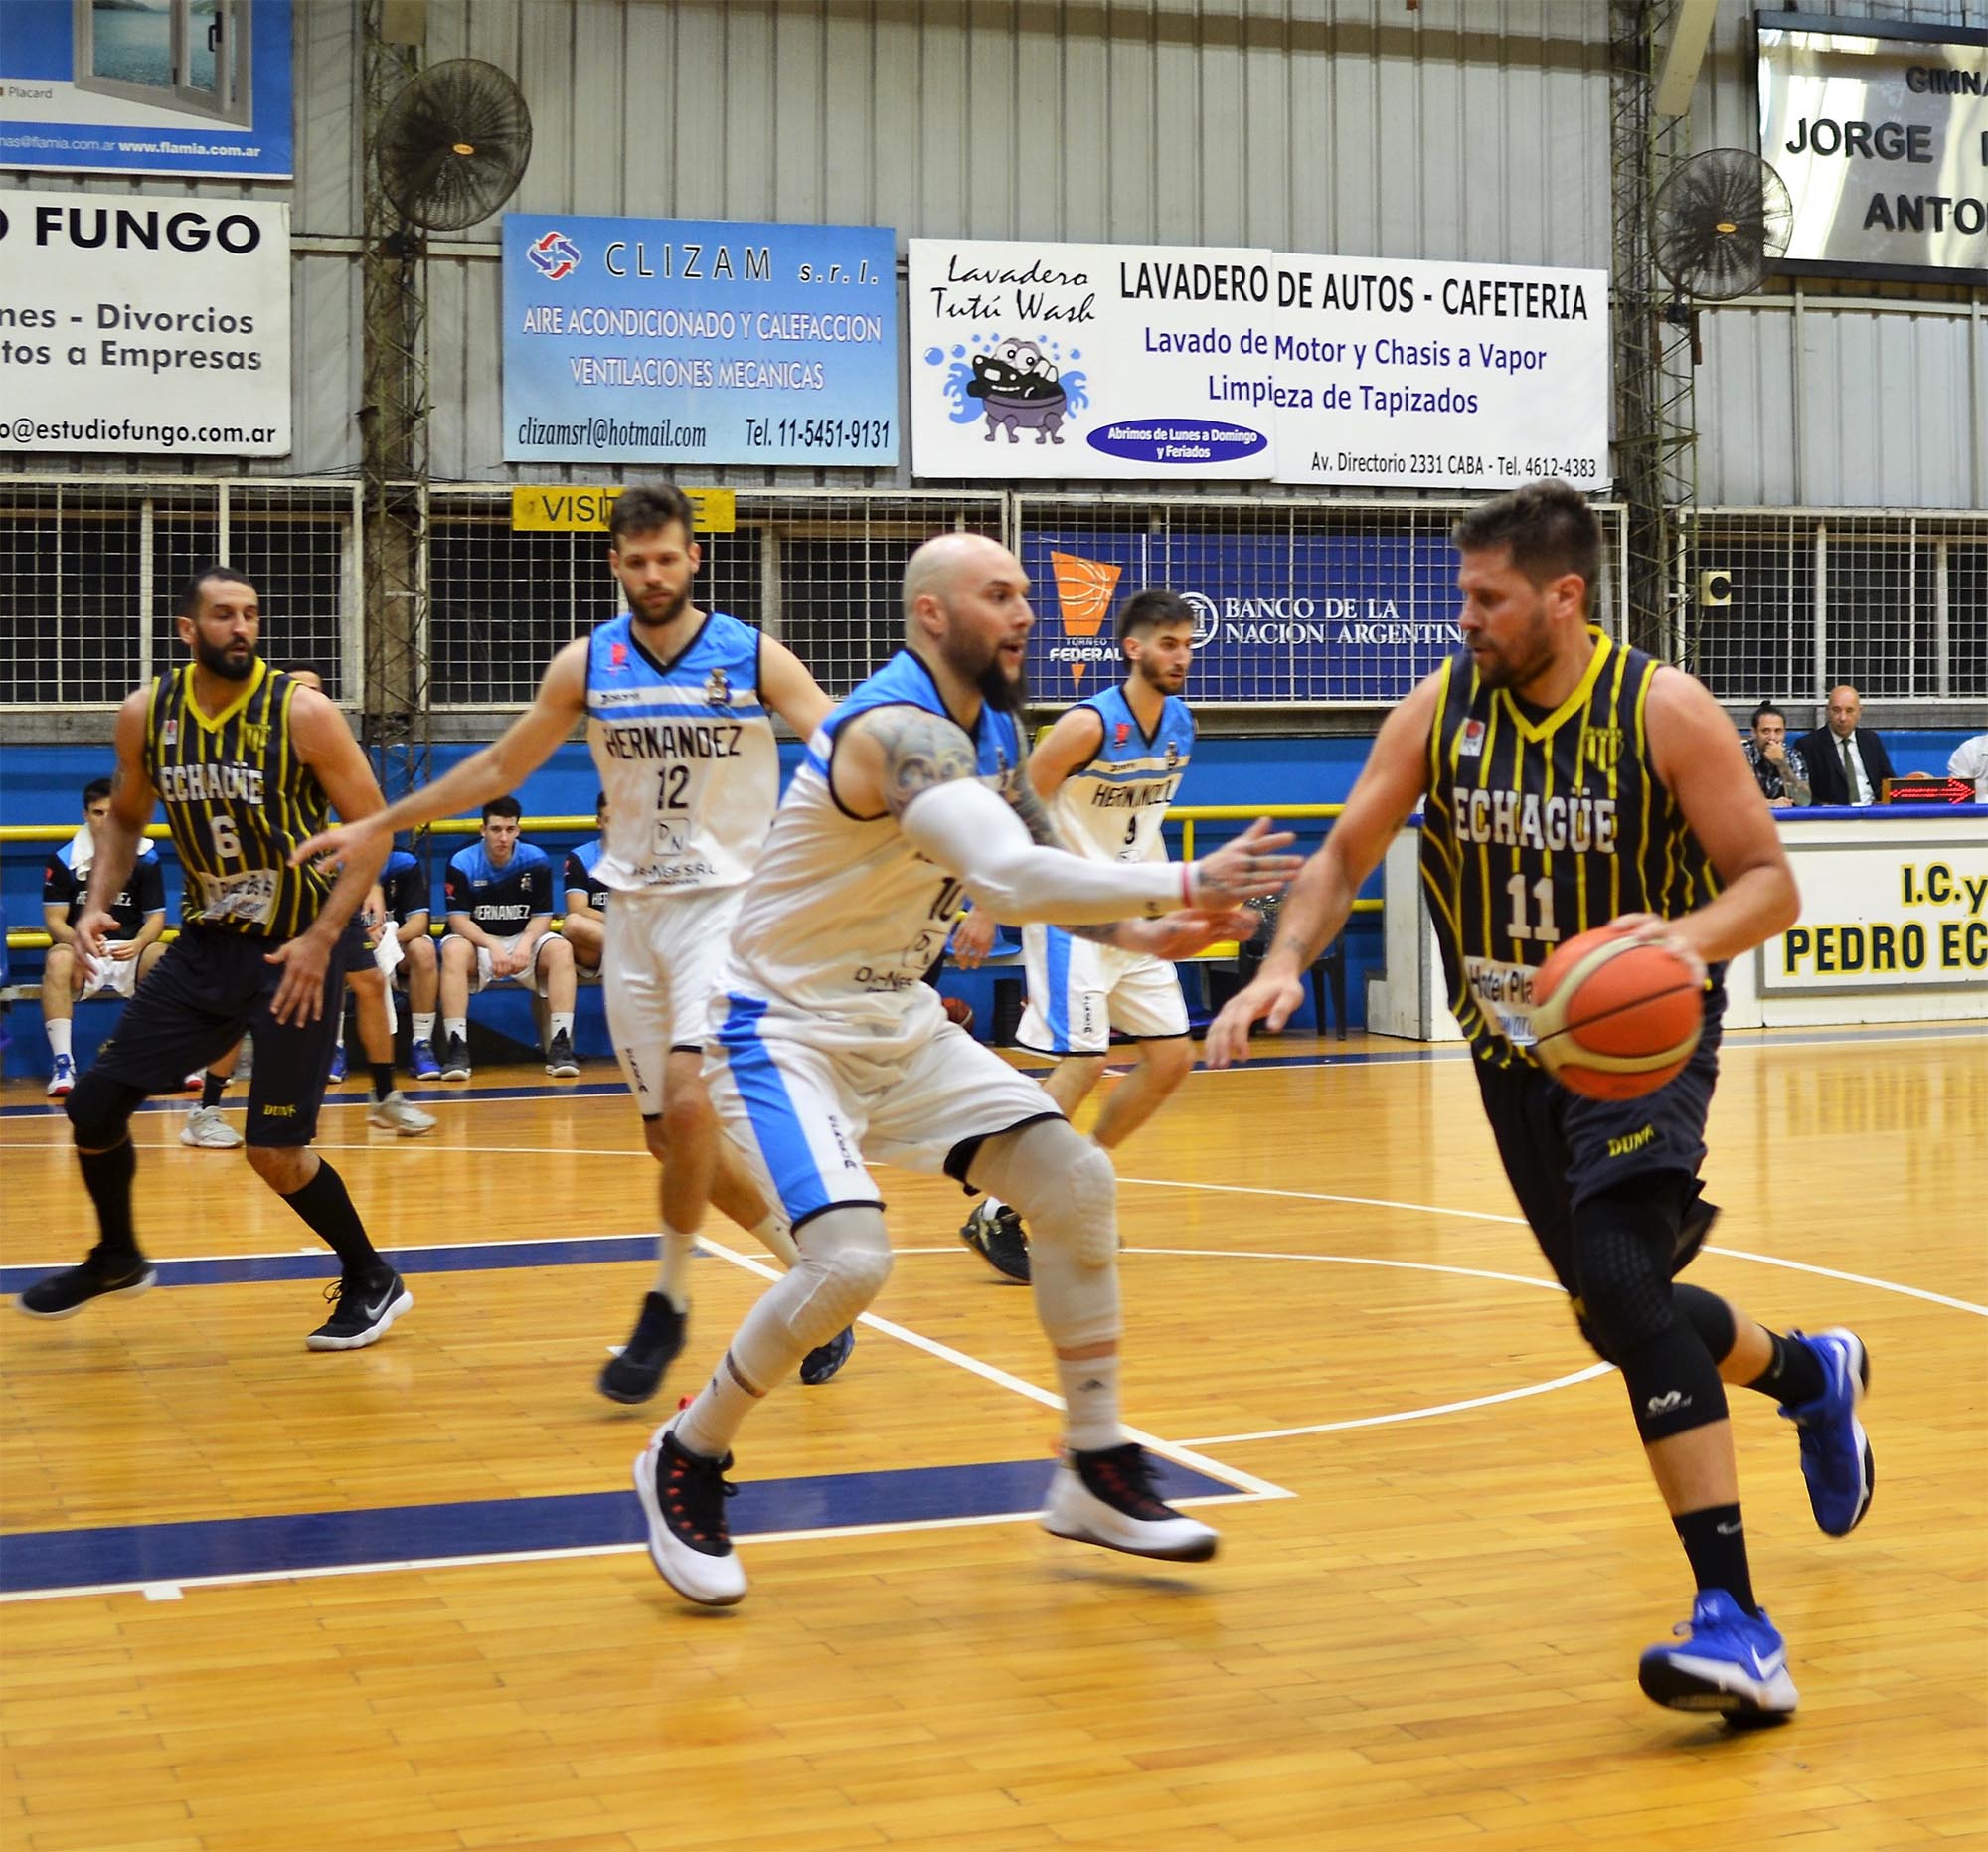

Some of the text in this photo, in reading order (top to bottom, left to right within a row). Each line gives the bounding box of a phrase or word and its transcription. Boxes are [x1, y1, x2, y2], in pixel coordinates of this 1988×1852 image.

[8, 86, 53, 100] Placard
[118, 141, 261, 158] www.flamia.com.ar
[1786, 118, 1933, 164] JORGE
[36, 206, 260, 254] FUNGO
[1862, 192, 1988, 235] ANTO
[604, 241, 879, 284] CLIZAM s.r.l.
[948, 254, 1089, 286] Lavadero
[930, 287, 1095, 323] Tutú Wash
[1120, 262, 1268, 302] LAVADERO
[1277, 270, 1313, 309] DE
[1322, 273, 1414, 313] AUTOS
[1442, 278, 1588, 320] CAFETERIA
[97, 303, 254, 335] Divorcios
[522, 305, 883, 343] AIRE ACONDICIONADO Y CALEFACCION
[68, 346, 86, 366] a
[101, 340, 262, 375] Empresas
[1145, 327, 1547, 375] Lavado de Motor y Chasis a Vapor
[570, 356, 824, 391] VENTILACIONES MECANICAS
[1209, 375, 1478, 418] Limpieza de Tapizados
[518, 417, 890, 449] clizamsrl@hotmail.com Tel. 11-5451-9131
[1107, 426, 1258, 445] Abrimos de Lunes a Domingo
[1156, 444, 1211, 460] y Feriados
[1311, 453, 1333, 472] Av.
[1338, 452, 1406, 474] Directorio
[1409, 455, 1443, 475] 2331
[1448, 455, 1484, 475] CABA
[1498, 457, 1521, 477] Tel.
[1525, 457, 1596, 478] 4612-4383
[542, 495, 706, 523] VISIE
[1225, 597, 1400, 620] BANCO DE LA
[1225, 623, 1467, 645] NACION ARGENTIN
[1049, 647, 1124, 662] FEDERAL
[604, 725, 744, 760] HERNANDEZ
[656, 764, 690, 810] 12
[209, 814, 242, 859] 6
[1452, 787, 1617, 854] ECHAGÜE
[1505, 873, 1561, 941] 11
[1784, 920, 1926, 973] PEDRO
